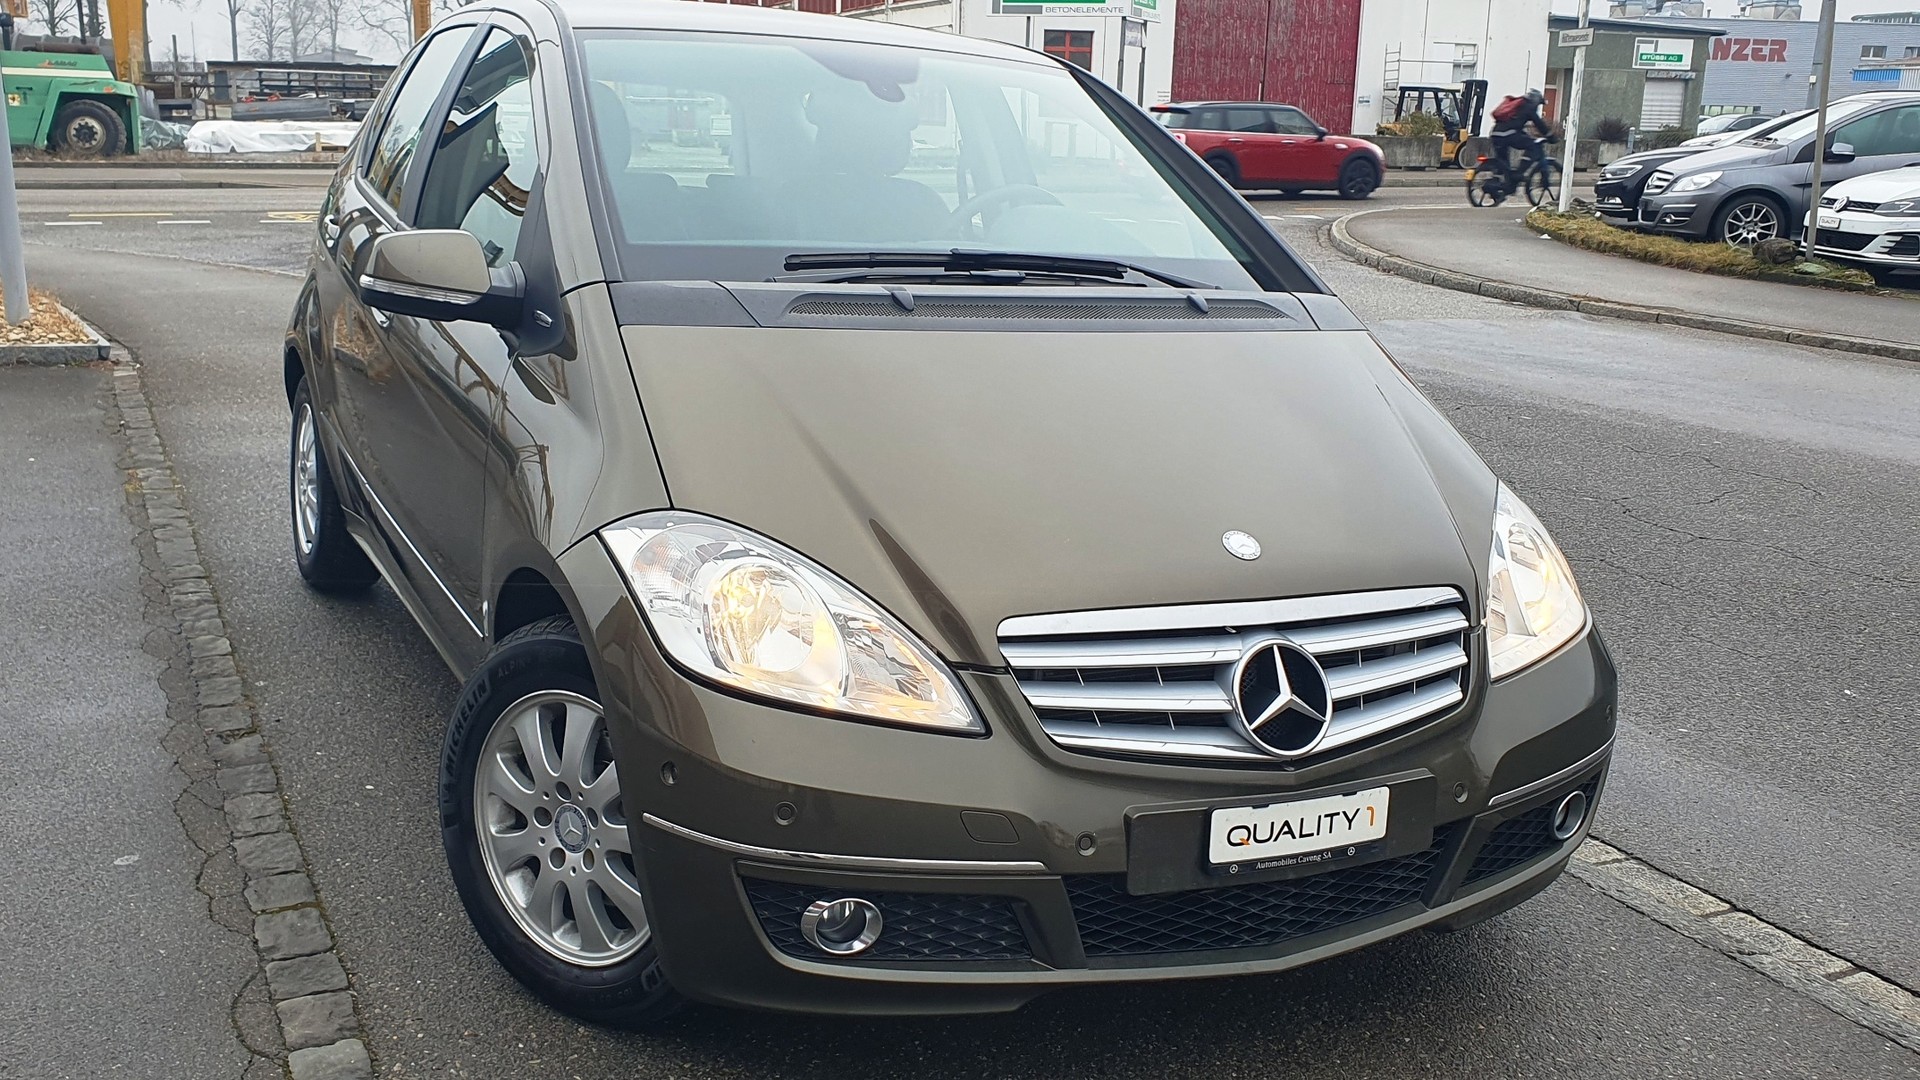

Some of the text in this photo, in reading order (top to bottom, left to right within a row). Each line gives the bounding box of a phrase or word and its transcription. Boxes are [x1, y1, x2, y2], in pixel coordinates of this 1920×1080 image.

[1709, 37, 1787, 62] NZER
[445, 678, 488, 777] MICHELIN
[1226, 806, 1375, 847] QUALITY 1
[1255, 858, 1297, 869] Automobiles
[1322, 851, 1332, 859] SA
